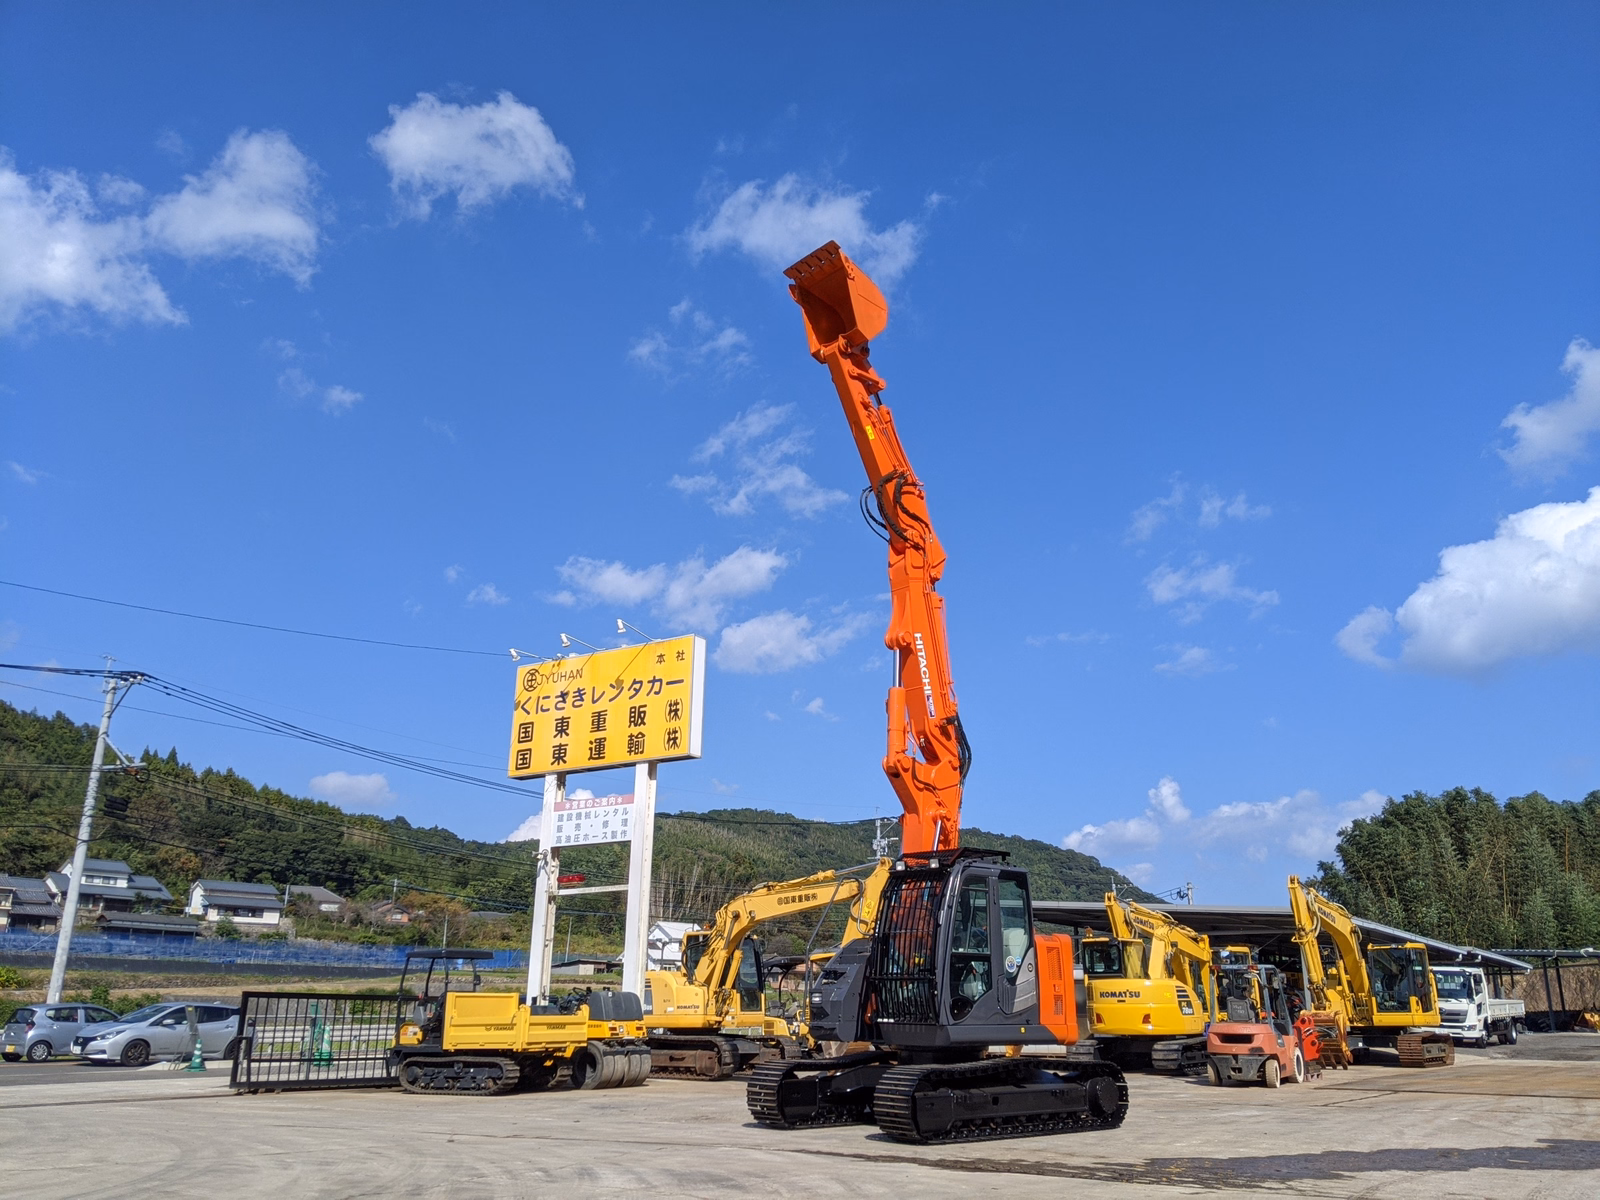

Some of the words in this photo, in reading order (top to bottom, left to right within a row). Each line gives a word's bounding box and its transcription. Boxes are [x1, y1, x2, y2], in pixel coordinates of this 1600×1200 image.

[914, 632, 933, 695] HITACHI
[520, 675, 685, 716] くにさきレンタカー
[1099, 989, 1141, 998] KOMATSU
